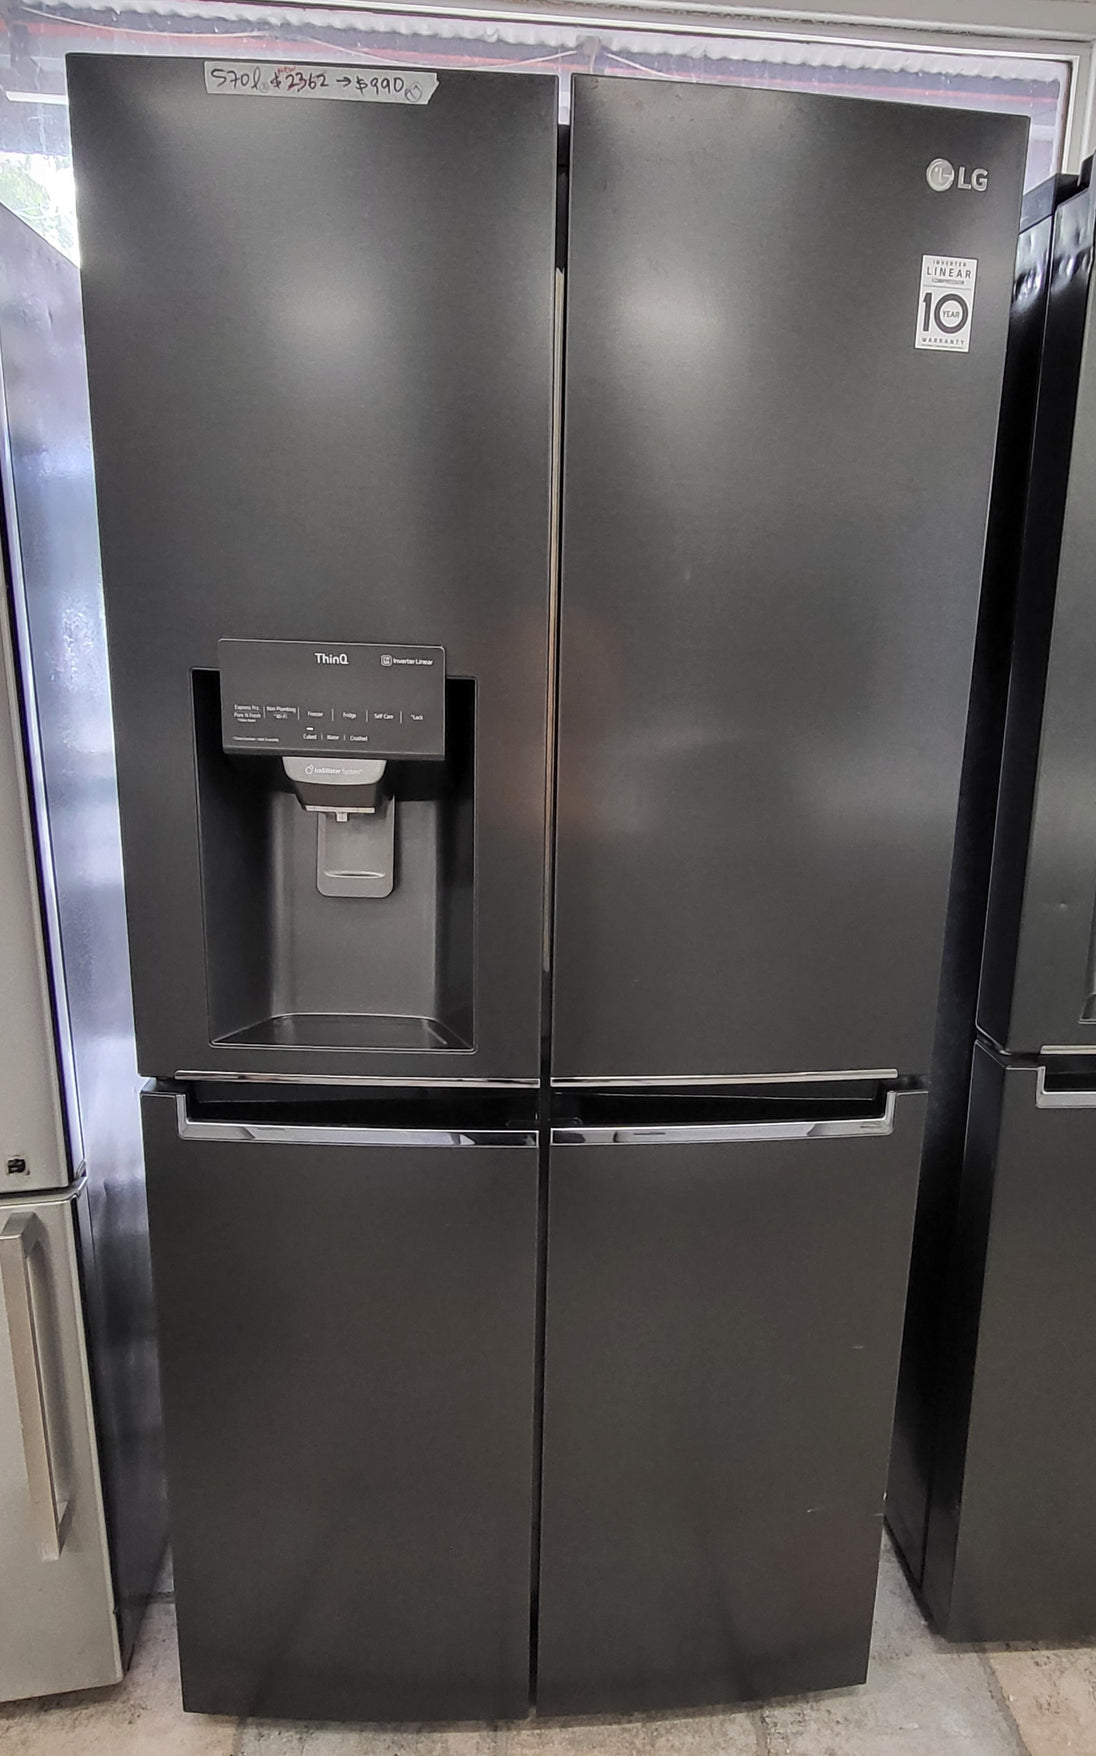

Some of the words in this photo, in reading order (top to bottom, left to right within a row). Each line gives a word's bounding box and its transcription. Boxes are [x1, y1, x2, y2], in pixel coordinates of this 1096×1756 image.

[355, 77, 405, 95] $990
[957, 166, 988, 192] LG
[926, 266, 972, 279] LINEAR
[922, 291, 969, 335] 10
[942, 310, 960, 319] YEAR
[921, 337, 965, 346] WARRANTY
[314, 653, 349, 665] ThinQ
